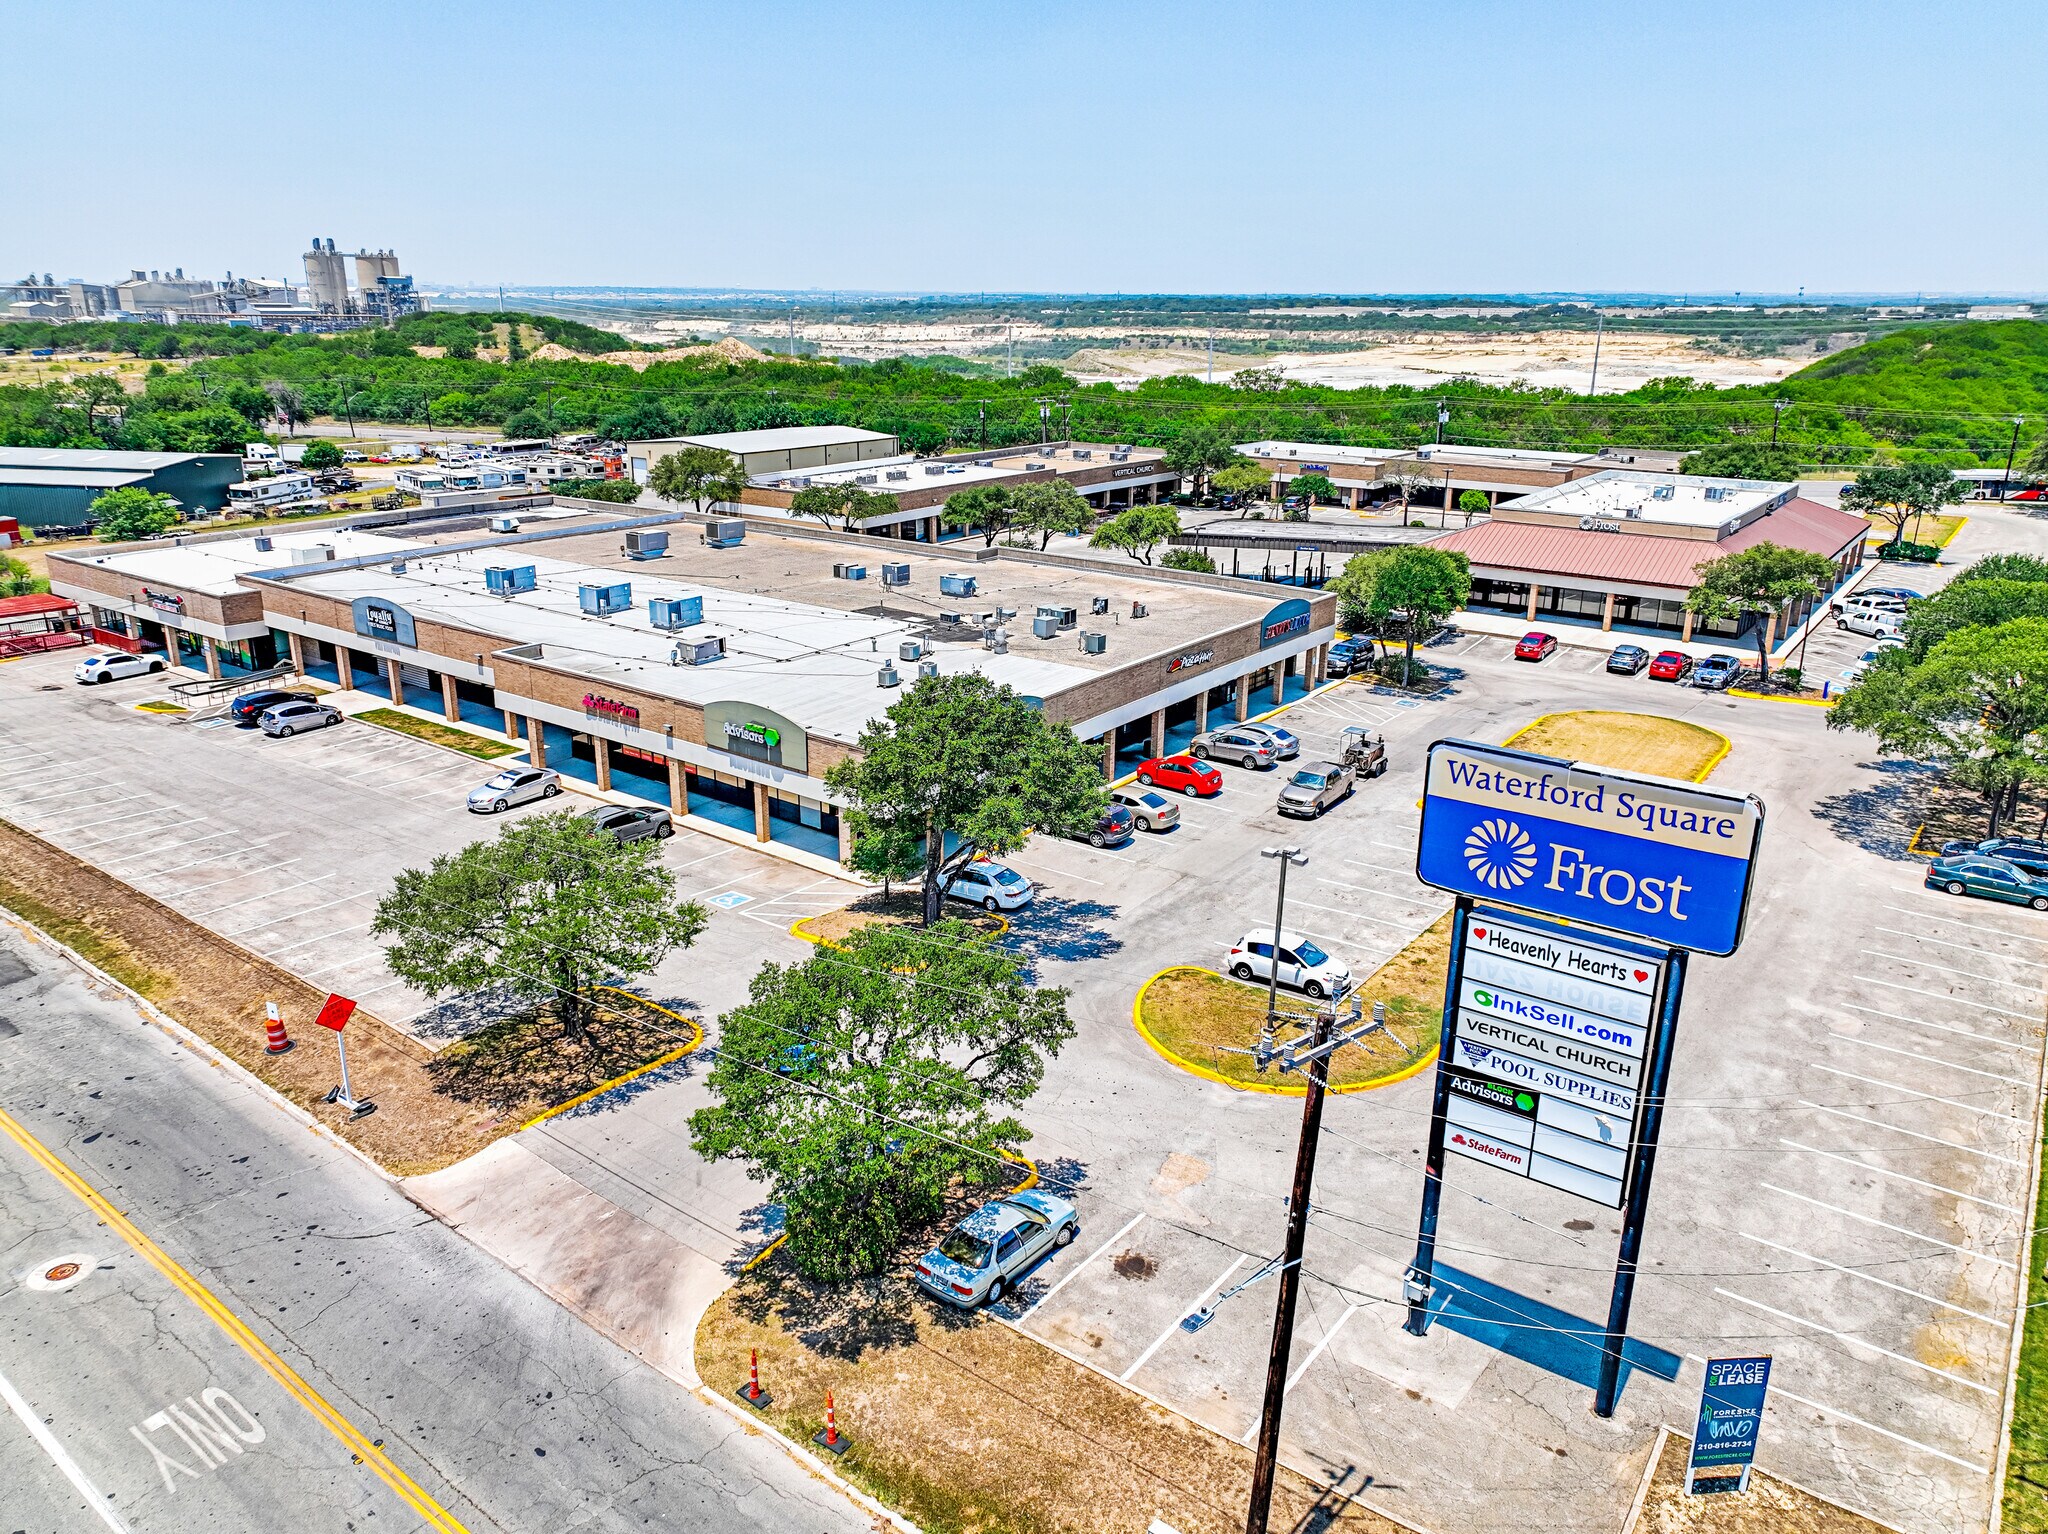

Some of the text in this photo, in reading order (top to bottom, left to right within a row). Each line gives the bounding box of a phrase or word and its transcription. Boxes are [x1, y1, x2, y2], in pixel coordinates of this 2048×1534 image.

[1114, 465, 1155, 477] VERTICAL CHURCH
[1593, 519, 1620, 530] Frost
[723, 721, 765, 744] Advisors
[1447, 759, 1736, 839] Waterford Square
[1544, 843, 1693, 921] Frost
[1488, 930, 1628, 982] Heavenly Hearts
[1493, 995, 1633, 1047] InkSell.com
[1466, 1018, 1631, 1077] VERTICAL CHURCH
[1451, 1076, 1514, 1106] Advisors
[1487, 1082, 1514, 1096] BLOCK
[1490, 1055, 1633, 1111] POOL SUPPLIES
[1709, 1375, 1719, 1387] FOR
[1711, 1362, 1766, 1376] SPACE
[1718, 1373, 1764, 1386] LEASE
[129, 1386, 267, 1494] ONLY
[1697, 1440, 1752, 1451] 210-816-2734
